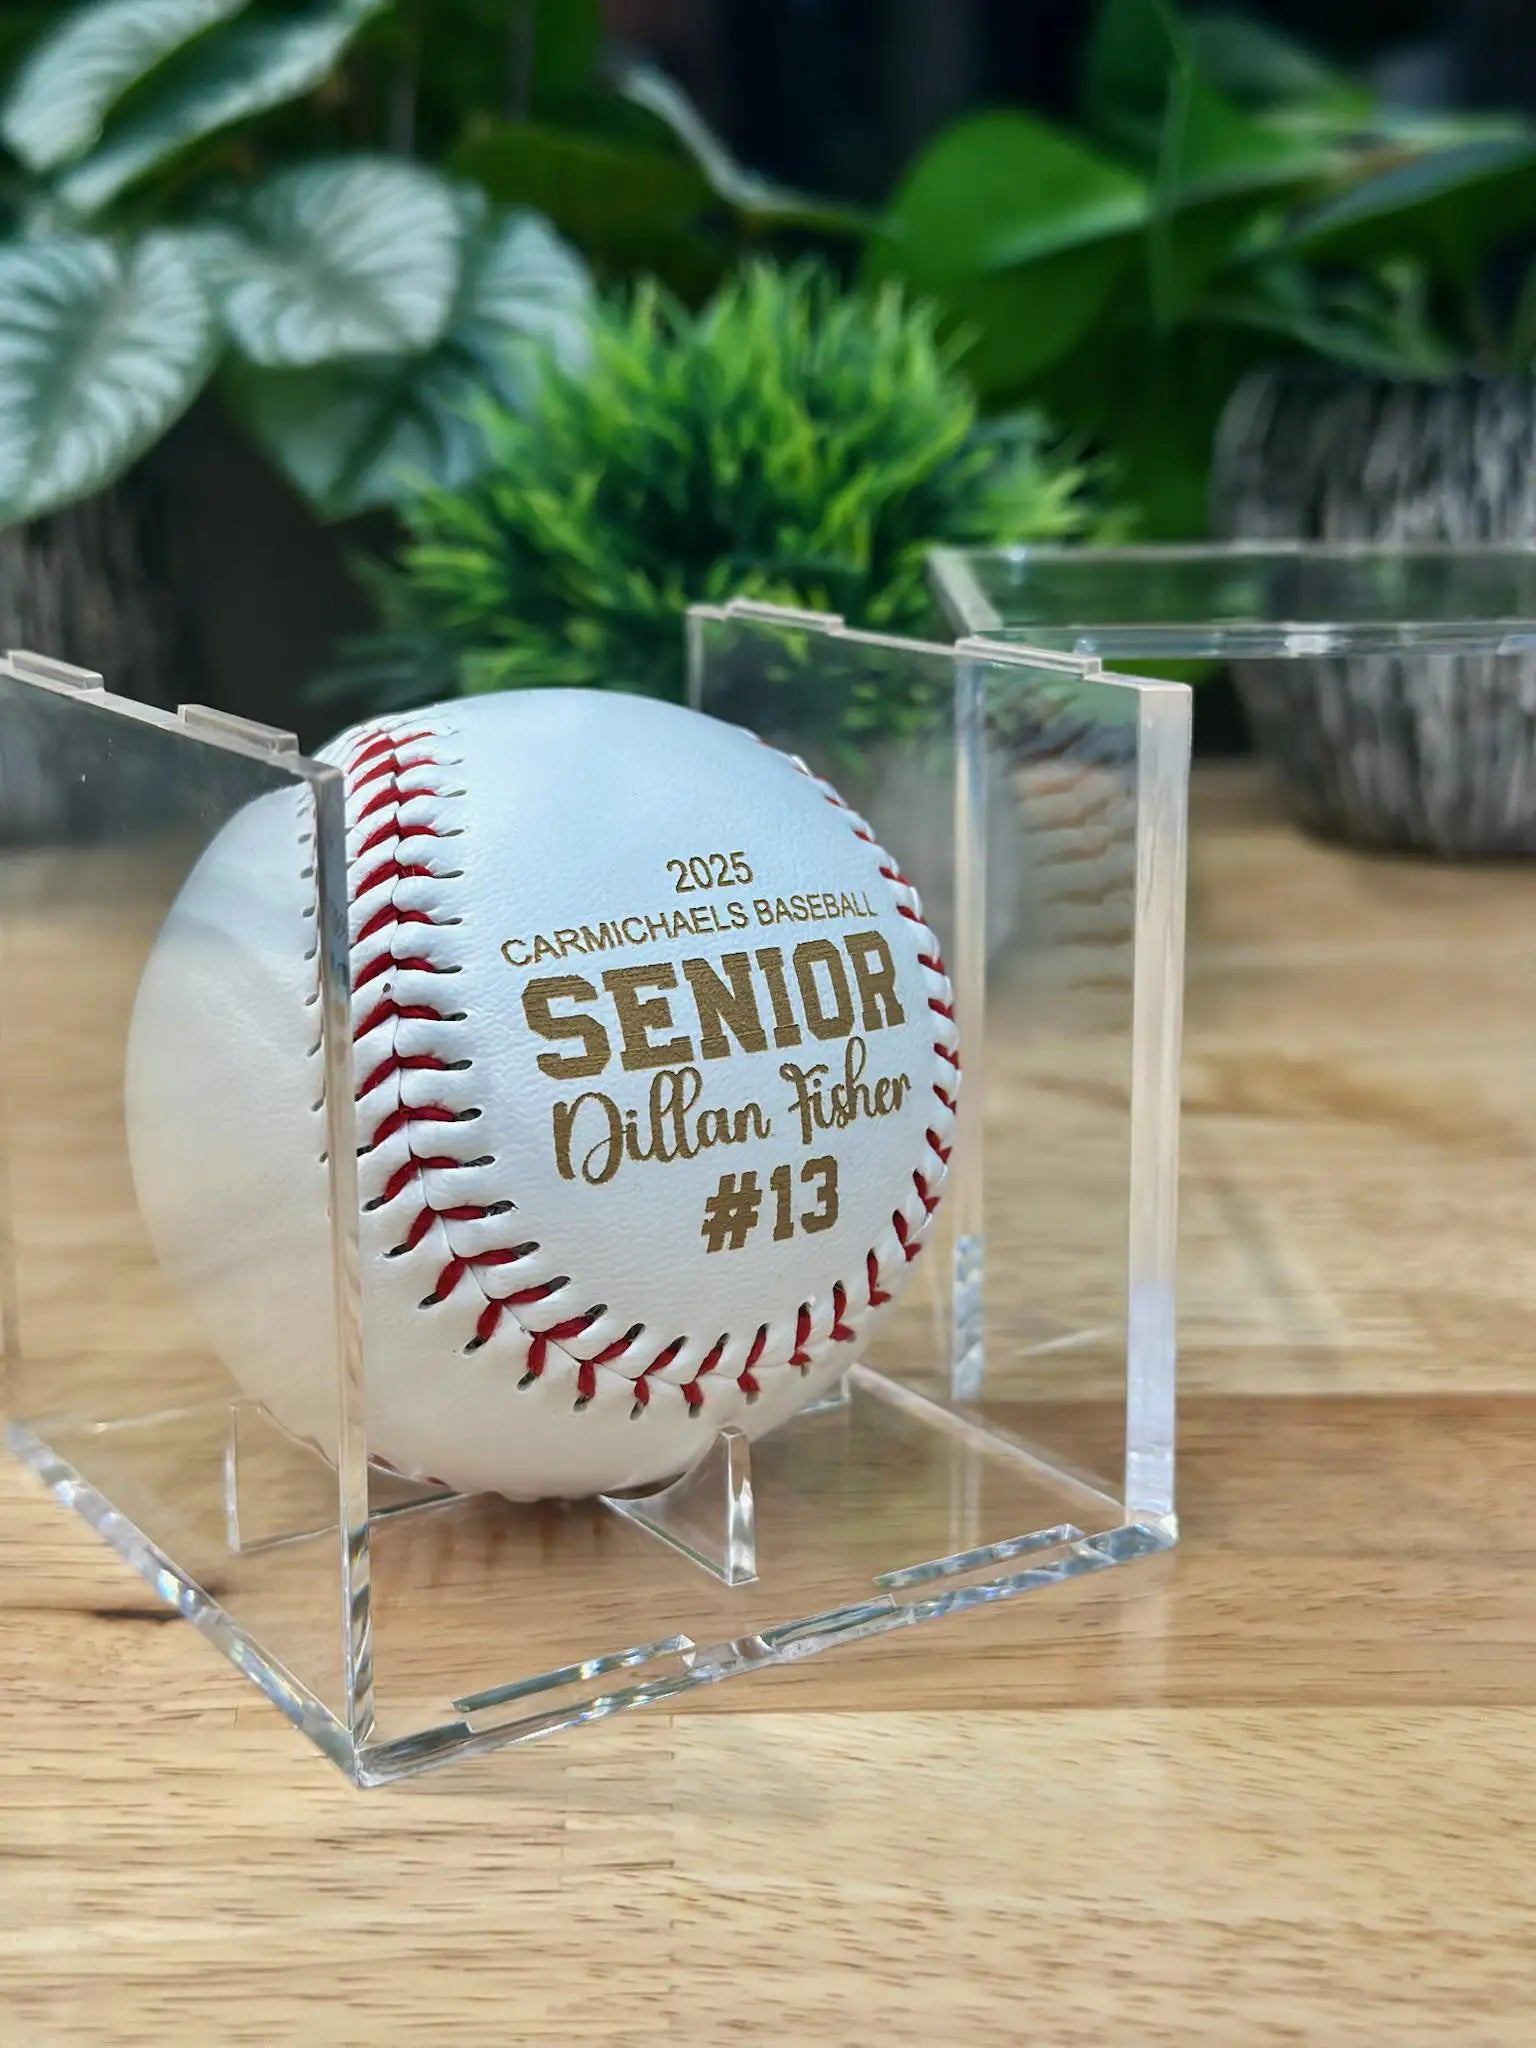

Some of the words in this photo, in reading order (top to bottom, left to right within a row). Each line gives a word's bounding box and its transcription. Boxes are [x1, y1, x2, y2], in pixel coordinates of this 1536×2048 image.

[666, 851, 753, 894] 2025
[500, 902, 749, 967] CARMICHAELS
[753, 891, 878, 926] BASEBALL
[520, 930, 905, 1080] SENIOR
[552, 1066, 771, 1185] Dillan
[779, 1036, 911, 1145] Fisher
[701, 1155, 840, 1254] #13
